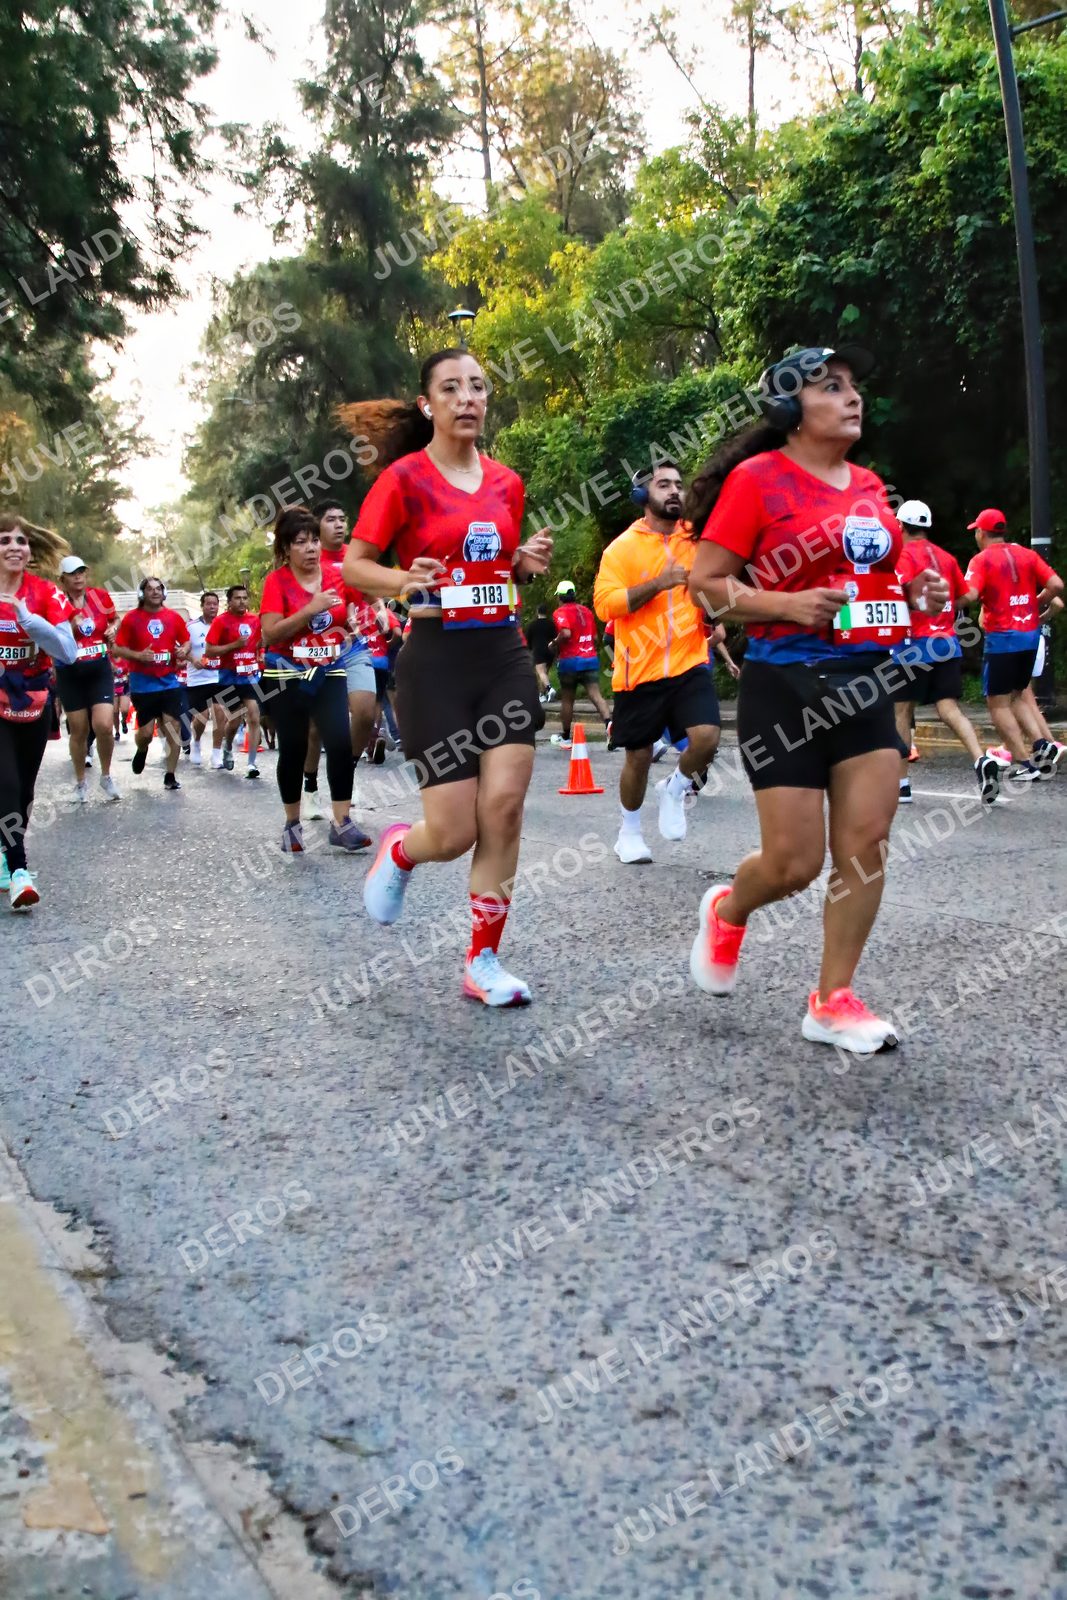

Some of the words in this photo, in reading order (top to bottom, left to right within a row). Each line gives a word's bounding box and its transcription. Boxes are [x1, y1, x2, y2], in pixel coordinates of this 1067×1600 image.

[471, 585, 503, 605] 3183
[865, 602, 898, 624] 3579
[0, 647, 26, 658] 2360
[308, 648, 329, 657] 2324
